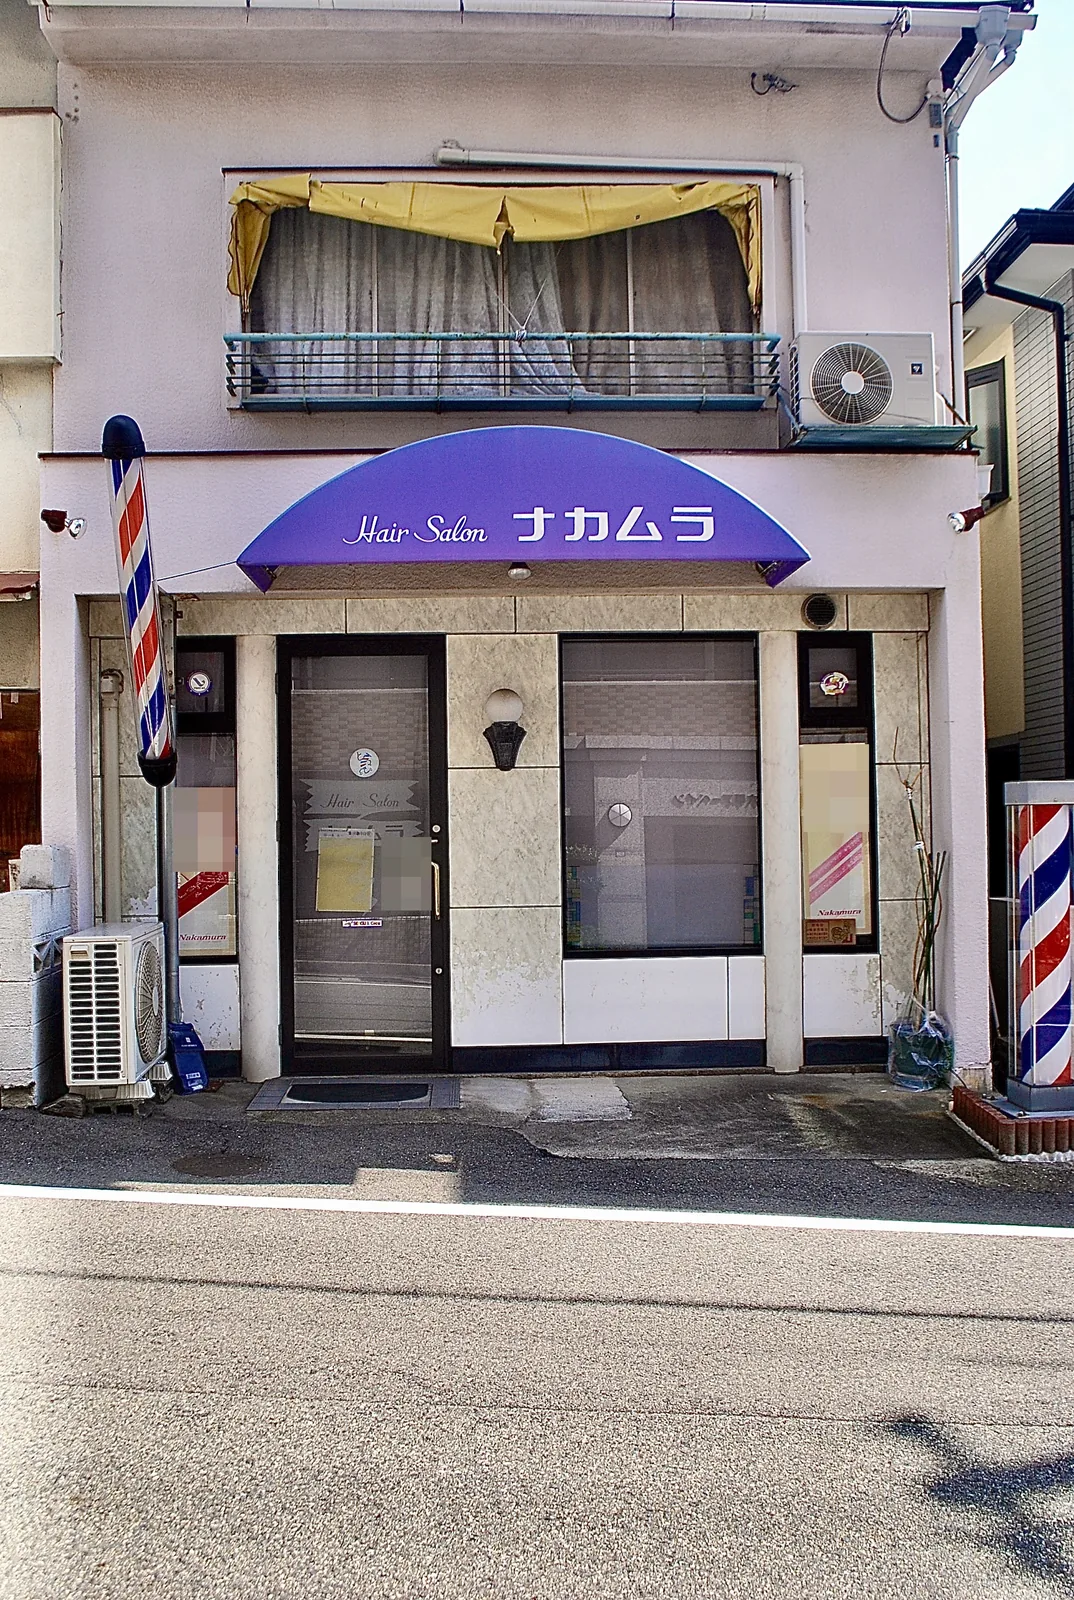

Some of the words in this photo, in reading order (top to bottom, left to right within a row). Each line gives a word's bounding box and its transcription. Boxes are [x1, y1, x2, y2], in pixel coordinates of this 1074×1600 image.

[342, 515, 410, 545] Hair
[413, 515, 488, 543] Salon
[512, 506, 715, 542] ナカムラ
[320, 793, 355, 809] Hair
[362, 792, 400, 808] Salon
[817, 908, 862, 917] Nakamura
[179, 933, 227, 941] Nakamura
